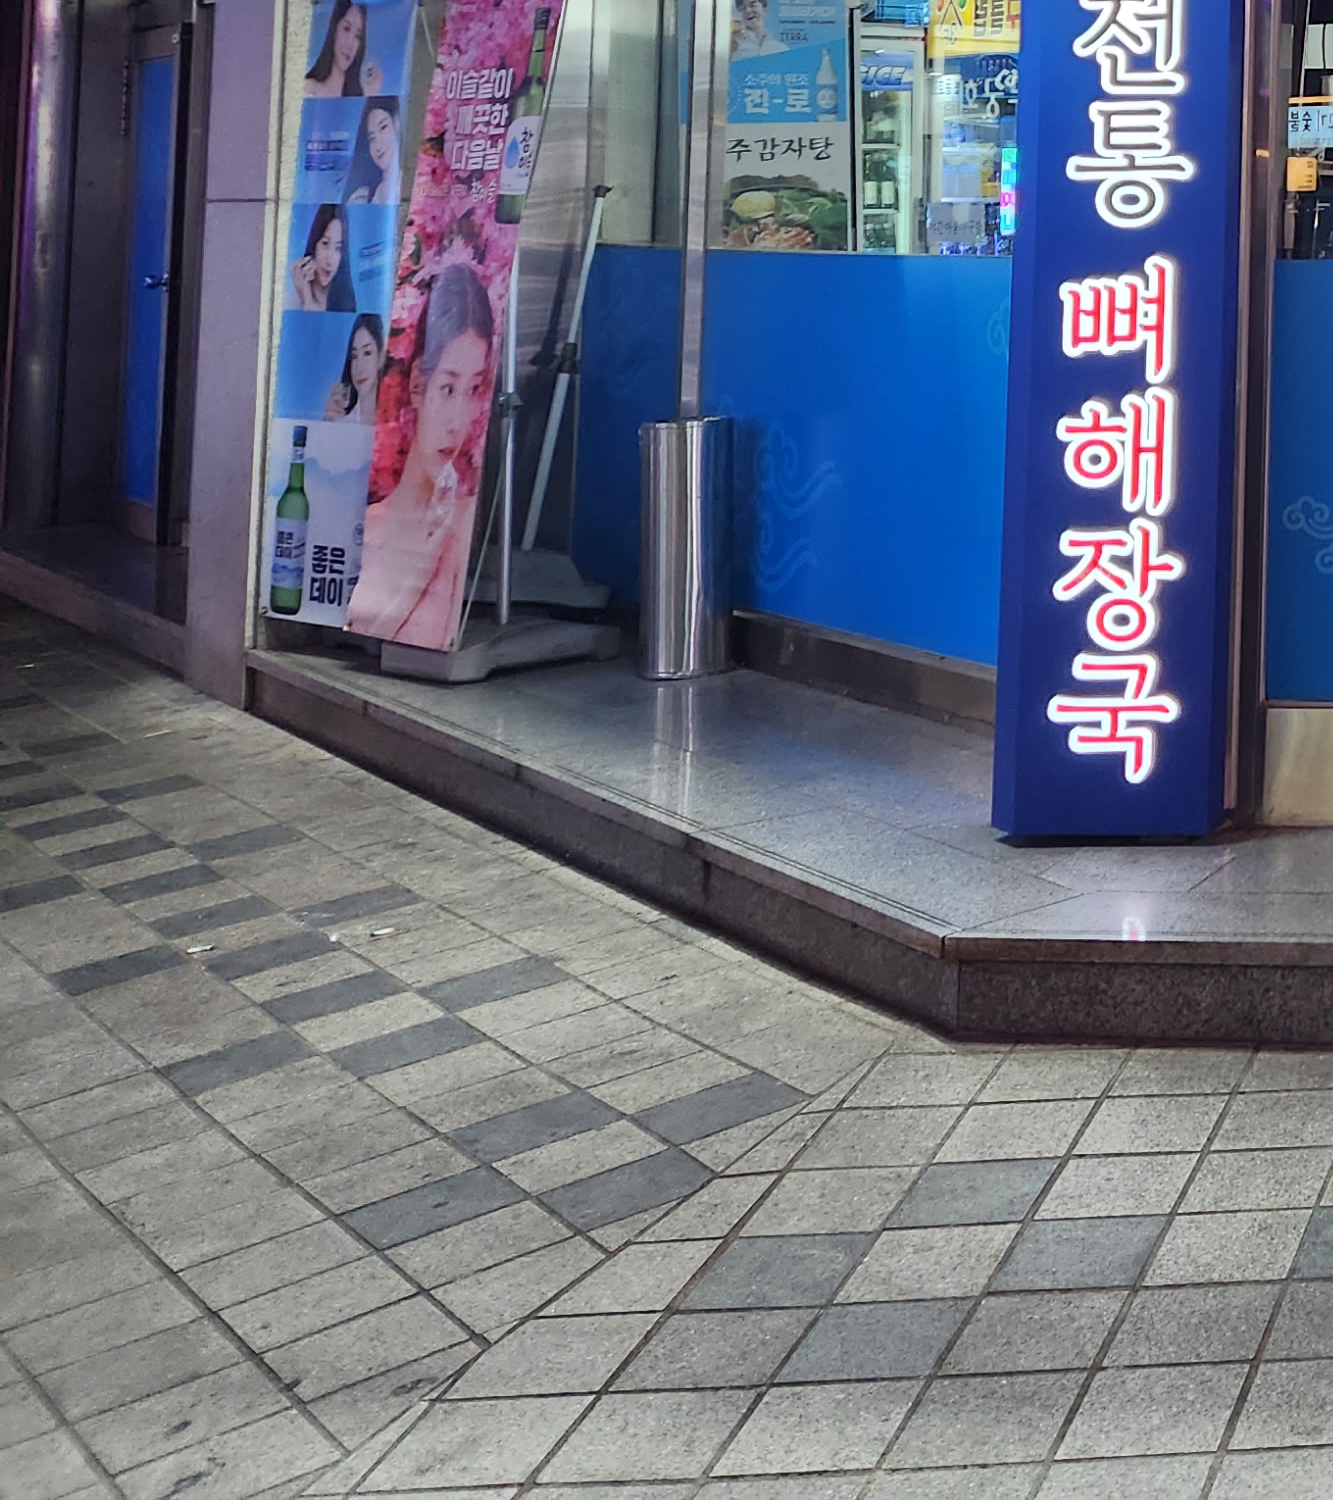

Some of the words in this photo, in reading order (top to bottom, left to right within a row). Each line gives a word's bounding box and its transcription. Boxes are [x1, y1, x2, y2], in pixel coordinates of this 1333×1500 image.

[446, 67, 514, 100] 이슬같이
[456, 103, 509, 135] 깨끗한
[451, 139, 504, 171] 다음날
[726, 136, 835, 162] 주감자탕
[1047, 254, 1186, 784] 뼈해장국
[312, 544, 345, 575] 좋은
[309, 576, 343, 607] 데이
